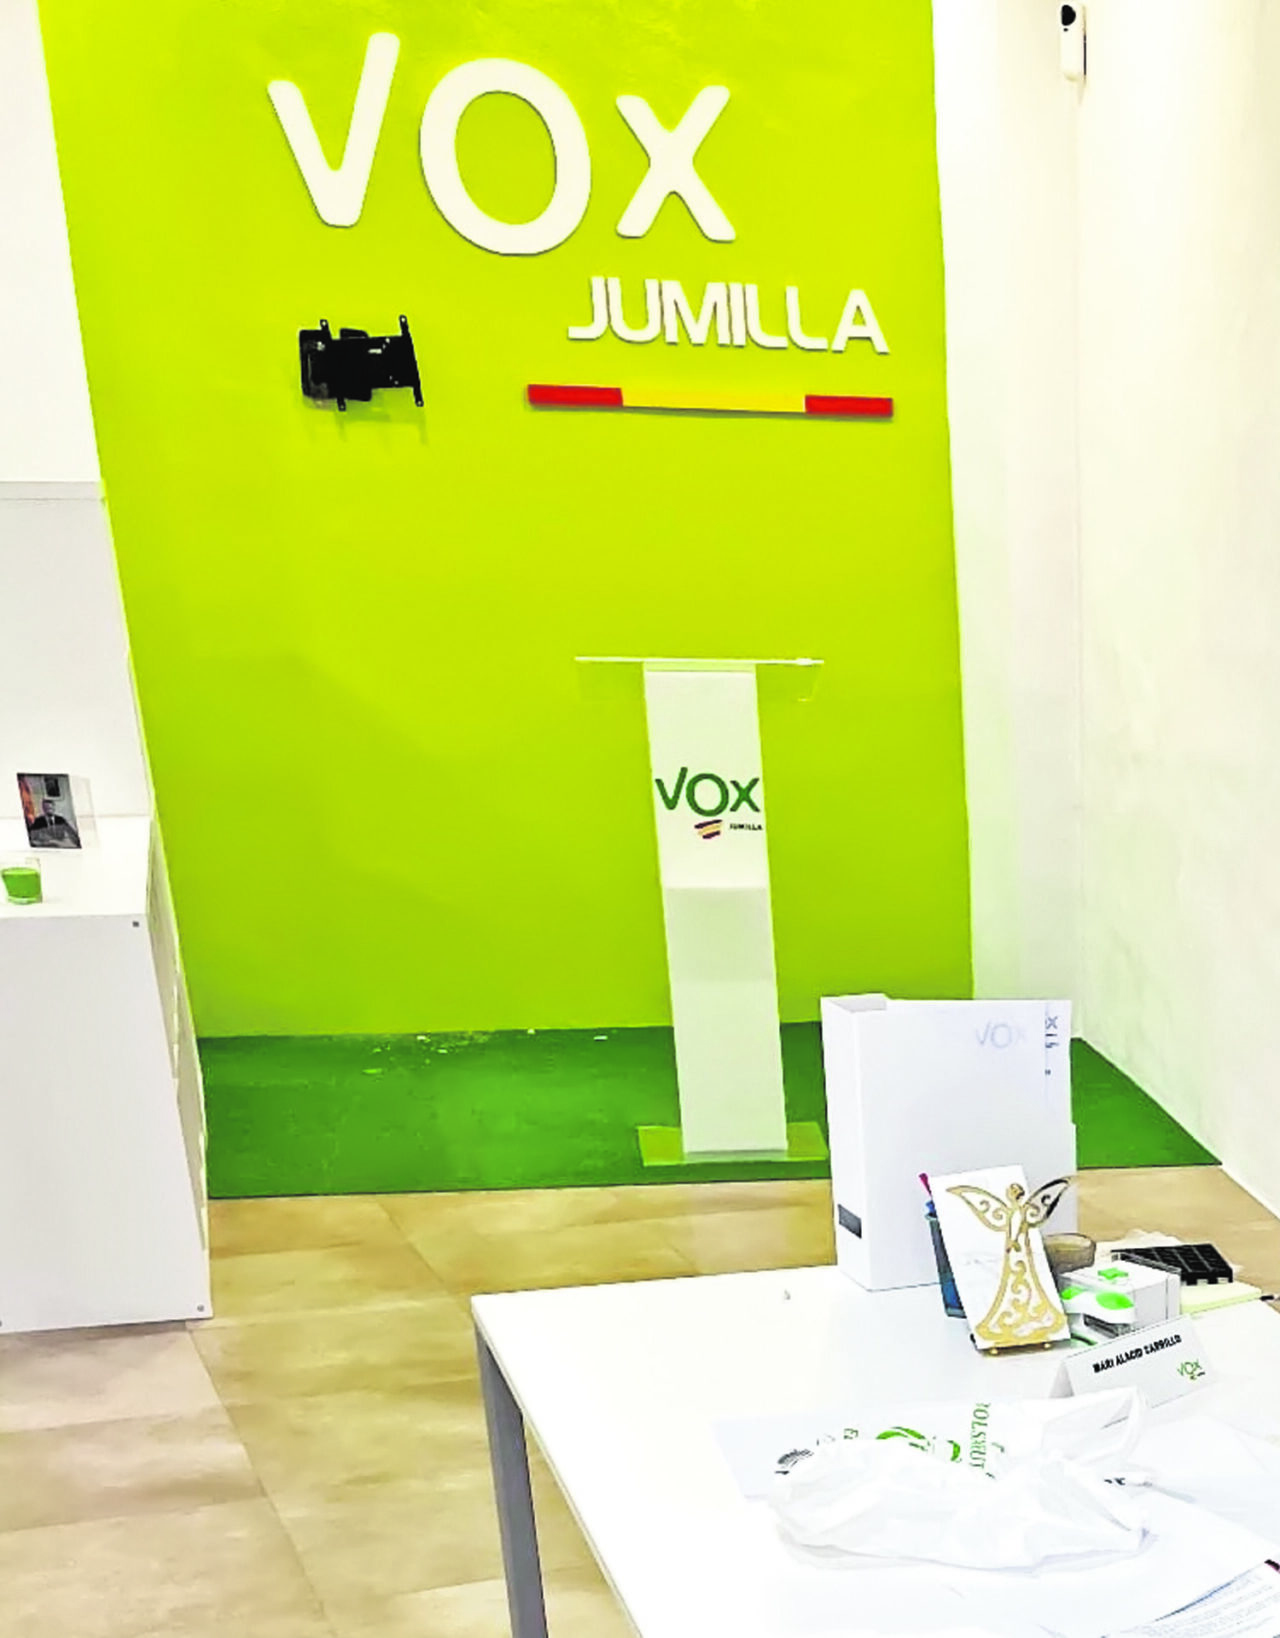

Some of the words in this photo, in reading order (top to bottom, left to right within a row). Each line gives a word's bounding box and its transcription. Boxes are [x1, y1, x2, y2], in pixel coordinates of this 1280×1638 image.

[267, 32, 737, 257] VOX
[567, 276, 889, 355] JUMILLA
[655, 766, 760, 817] VOX
